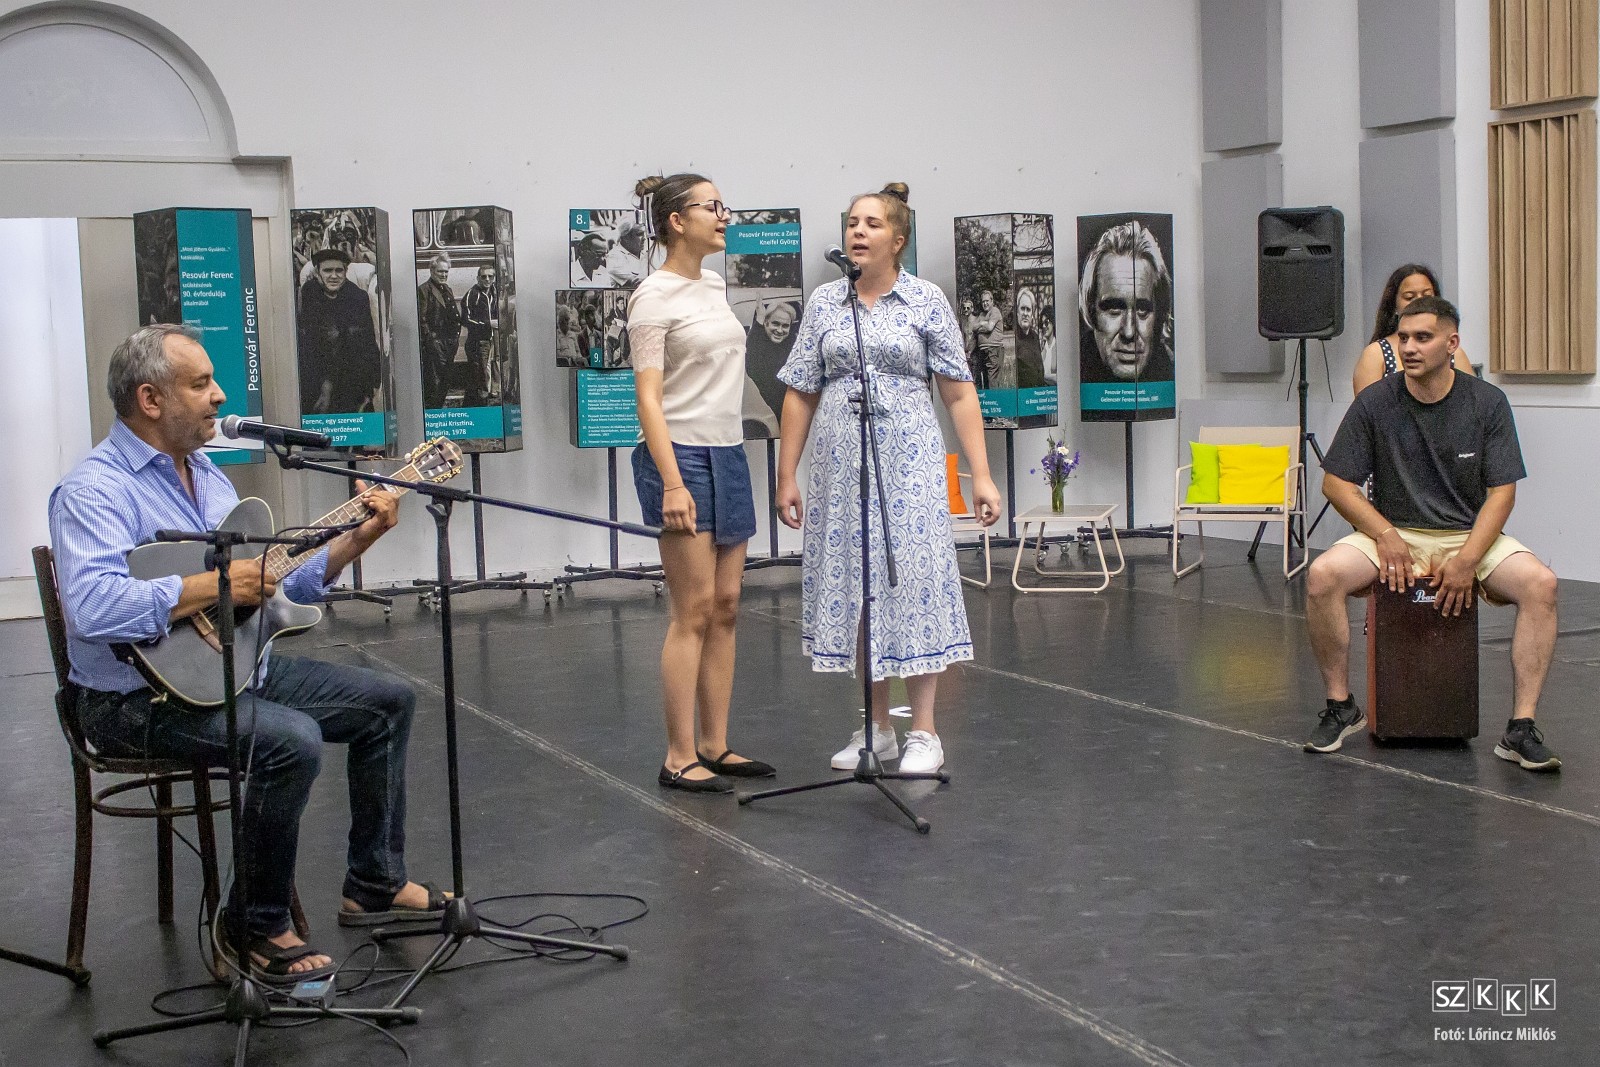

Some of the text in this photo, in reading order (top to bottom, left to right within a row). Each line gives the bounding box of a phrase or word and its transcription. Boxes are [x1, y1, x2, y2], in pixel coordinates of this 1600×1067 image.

[576, 214, 587, 225] 8.
[761, 230, 781, 238] Ferenc
[182, 271, 234, 279] Pesovár Ferenc
[182, 290, 226, 298] 90. évfordulója
[244, 287, 259, 391] Pesovár Ferenc
[593, 352, 601, 363] 9.
[337, 416, 364, 424] szervező
